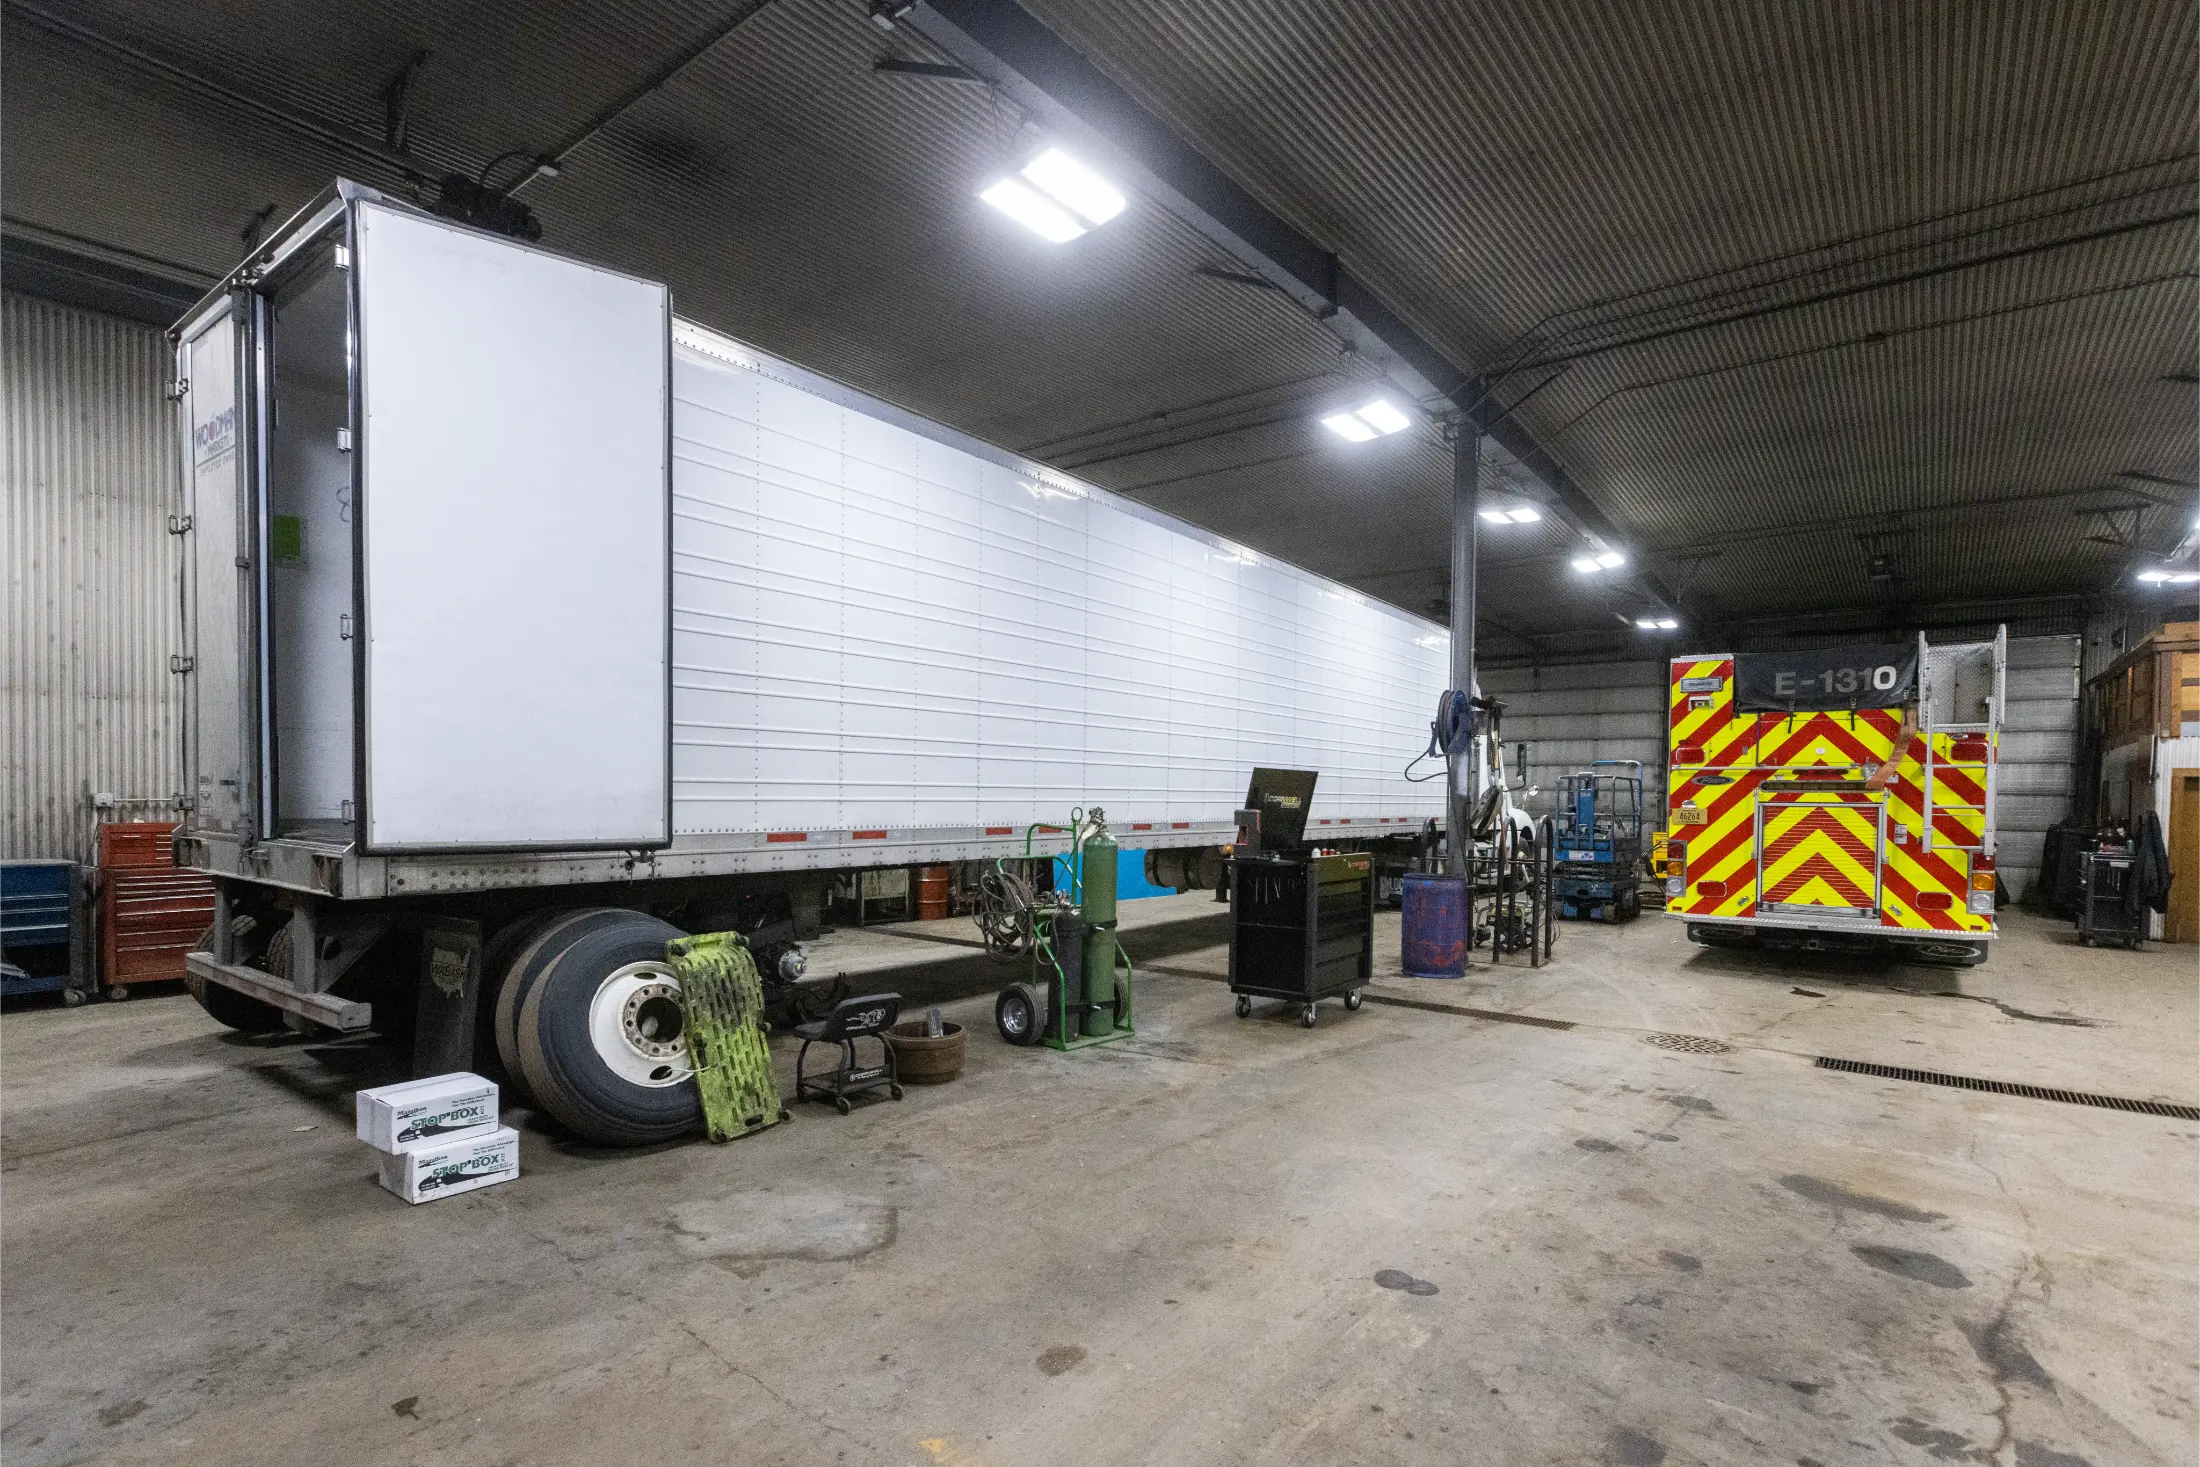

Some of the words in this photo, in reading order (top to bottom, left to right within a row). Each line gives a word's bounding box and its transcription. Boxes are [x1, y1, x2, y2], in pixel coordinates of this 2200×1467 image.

[1775, 665, 1897, 695] E-1310
[1679, 812, 1700, 821] 46264
[397, 1106, 427, 1116] Marathon
[418, 1155, 448, 1165] Marathon
